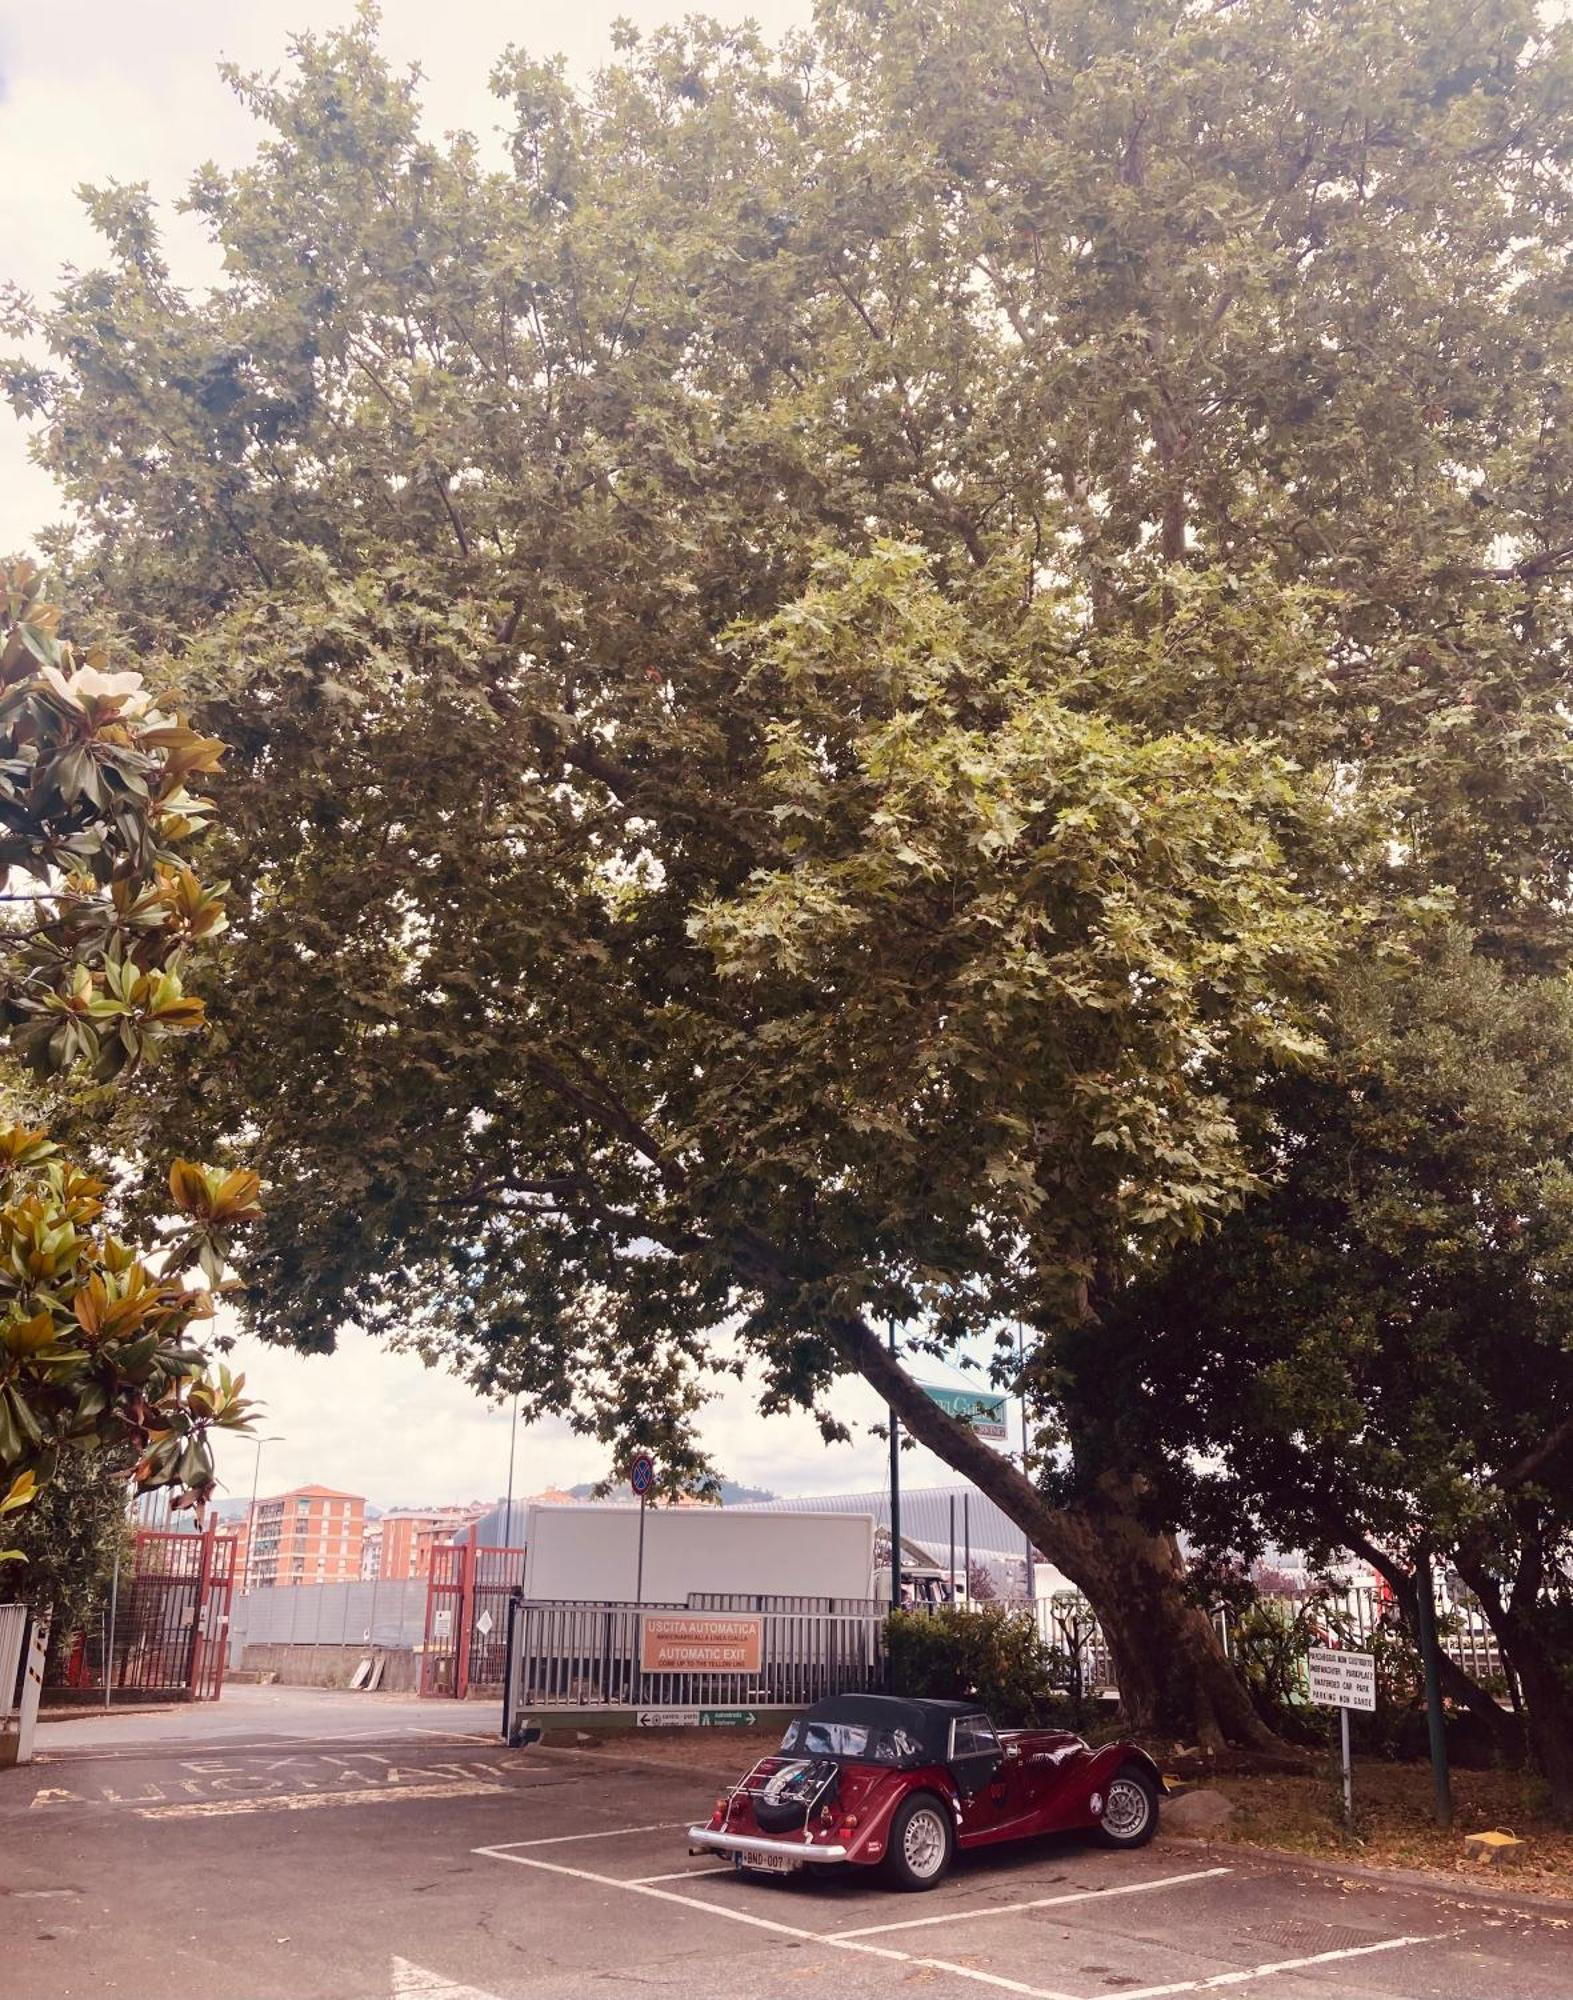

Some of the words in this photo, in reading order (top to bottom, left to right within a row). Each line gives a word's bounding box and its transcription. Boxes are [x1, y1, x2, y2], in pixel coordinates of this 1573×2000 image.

[648, 1621, 687, 1633] USCITA
[689, 1622, 757, 1634] AUTOMATICA
[659, 1648, 721, 1660] AUTOMATIC
[723, 1649, 747, 1660] EXIT
[1356, 1684, 1369, 1693] PARK
[1312, 1690, 1336, 1701] PARKING
[179, 1753, 391, 1773] EXIT
